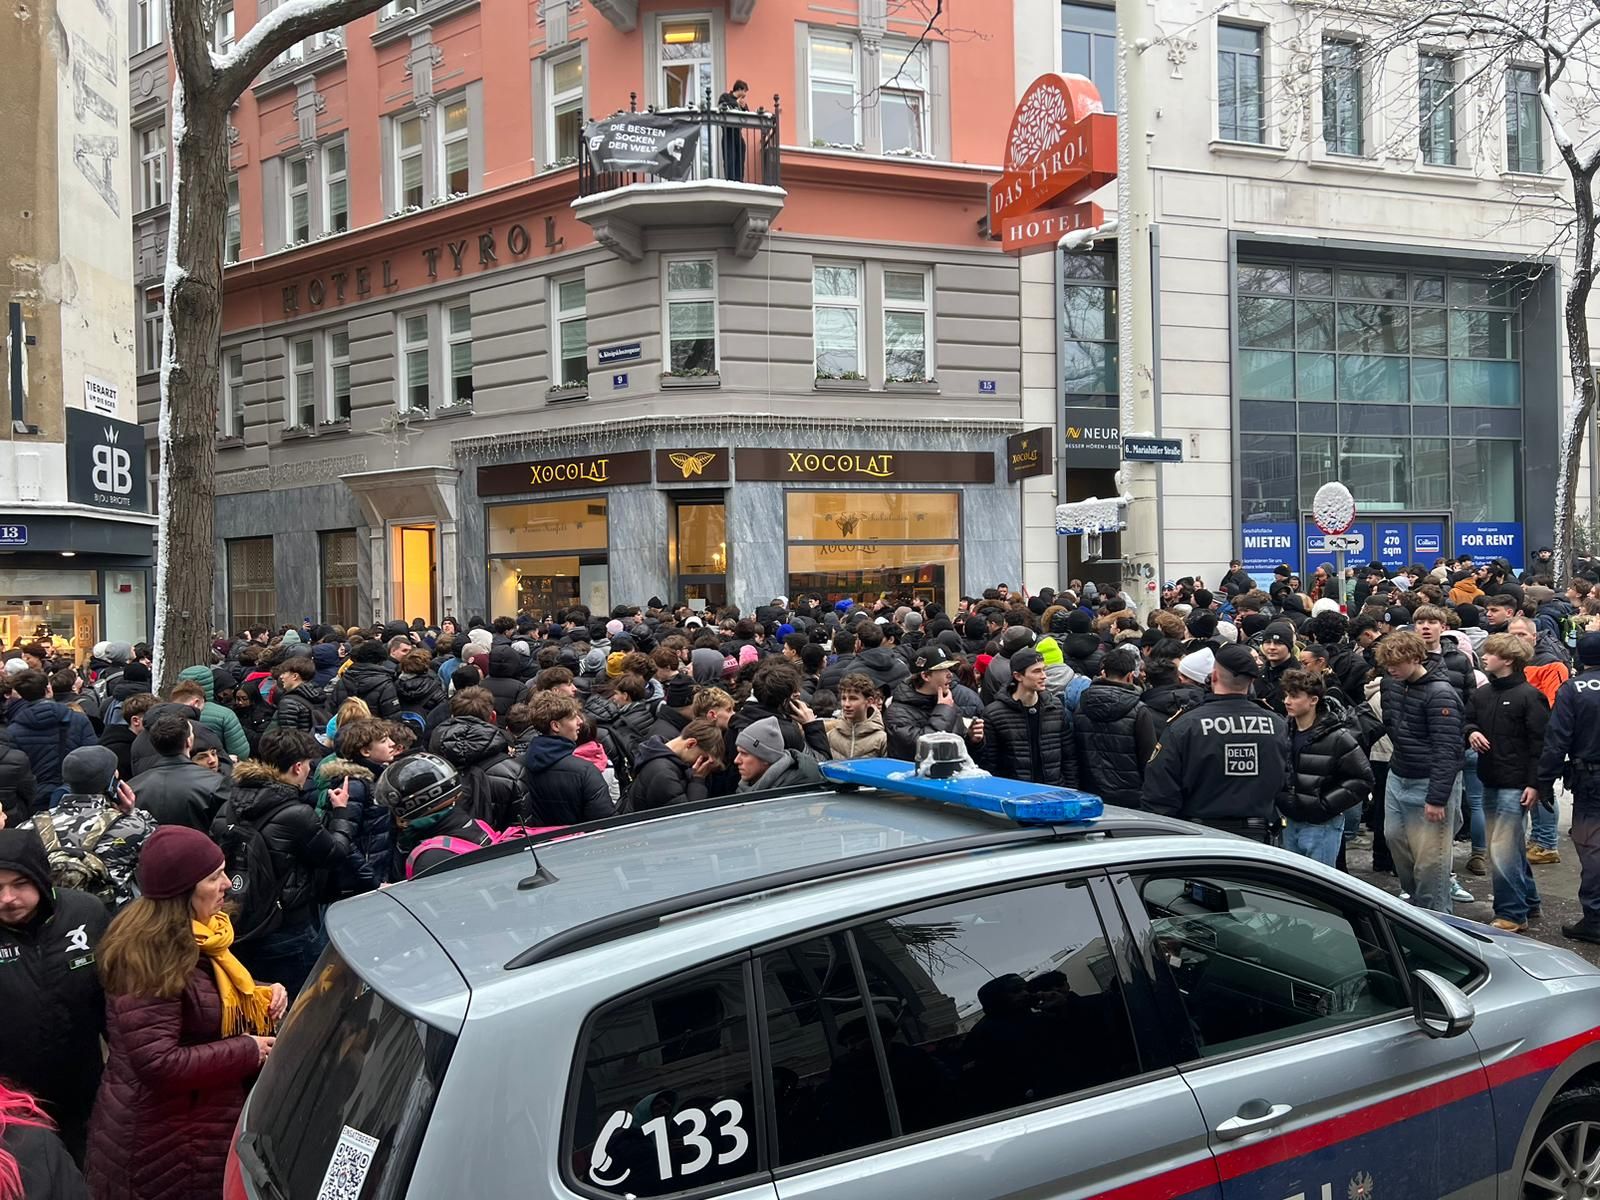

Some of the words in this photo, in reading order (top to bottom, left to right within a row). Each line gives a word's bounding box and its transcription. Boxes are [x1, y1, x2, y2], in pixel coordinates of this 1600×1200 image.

[610, 123, 625, 132] DIE
[627, 124, 666, 138] BESTEN
[615, 132, 656, 145] SOCKEN
[608, 140, 628, 151] DER
[994, 178, 1023, 214] DAS
[1029, 135, 1088, 189] TYROL
[1010, 213, 1085, 241] HOTEL
[281, 259, 399, 313] HOTEL
[422, 215, 564, 277] TYROL
[617, 375, 623, 384] 9
[983, 381, 993, 390] 15
[86, 380, 117, 400] TIERARZT
[1084, 427, 1119, 440] NEUR
[787, 452, 894, 477] XOCOLAT
[530, 459, 610, 485] XOCOLAT
[1, 526, 19, 538] 13
[1244, 535, 1291, 548] MIETEN
[1384, 536, 1400, 545] 470
[1417, 538, 1437, 546] Colliers
[1461, 534, 1483, 546] FOR
[1485, 534, 1514, 546] RENT
[1383, 547, 1402, 557] sqm
[1574, 679, 1600, 693] PO
[1200, 716, 1275, 735] POLIZEI
[1228, 748, 1255, 757] DELTA
[1229, 760, 1254, 770] 700
[641, 1099, 749, 1180] 133
